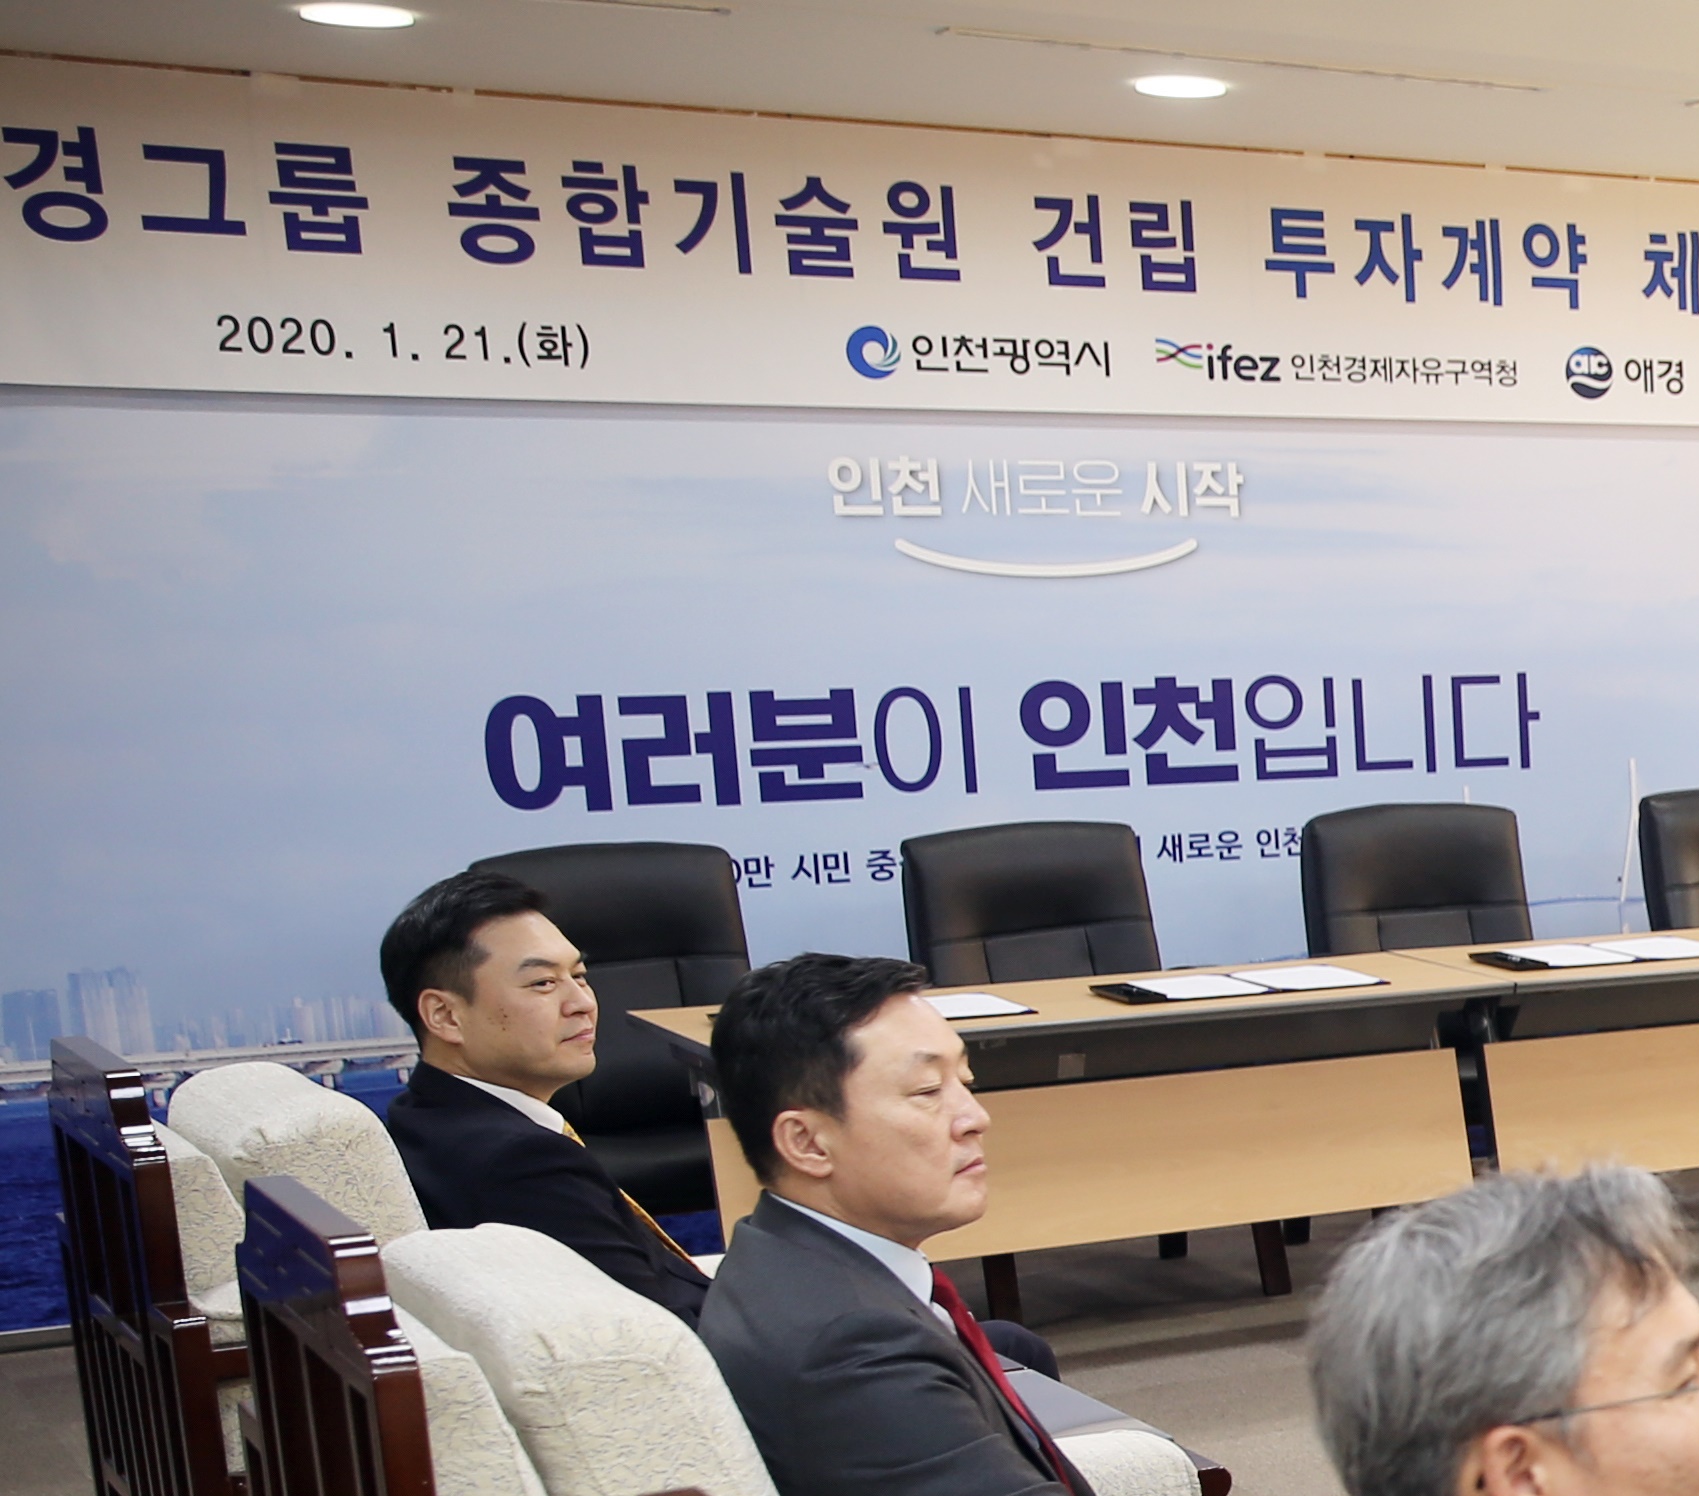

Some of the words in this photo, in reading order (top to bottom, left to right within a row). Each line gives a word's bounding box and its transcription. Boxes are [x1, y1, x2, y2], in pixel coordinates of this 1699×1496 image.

[1, 125, 369, 256] 경그룹
[447, 154, 962, 283] 종합기술원
[1031, 193, 1199, 293] 건립
[1263, 206, 1588, 310] 투자계약
[215, 315, 355, 360] 2020.
[912, 335, 1112, 377] 인천광역시
[1206, 344, 1281, 383] ifez
[1291, 353, 1519, 388] 인천경제자유구역청
[1625, 358, 1684, 395] 애경
[828, 455, 942, 517] 인천
[961, 458, 1124, 517] 새로운
[1140, 460, 1245, 518] 시작
[484, 685, 979, 812] 여러분이
[1019, 671, 1540, 791] 인천입니다
[791, 851, 851, 884] 시민
[866, 849, 903, 881] 중
[1157, 829, 1243, 863] 새로운
